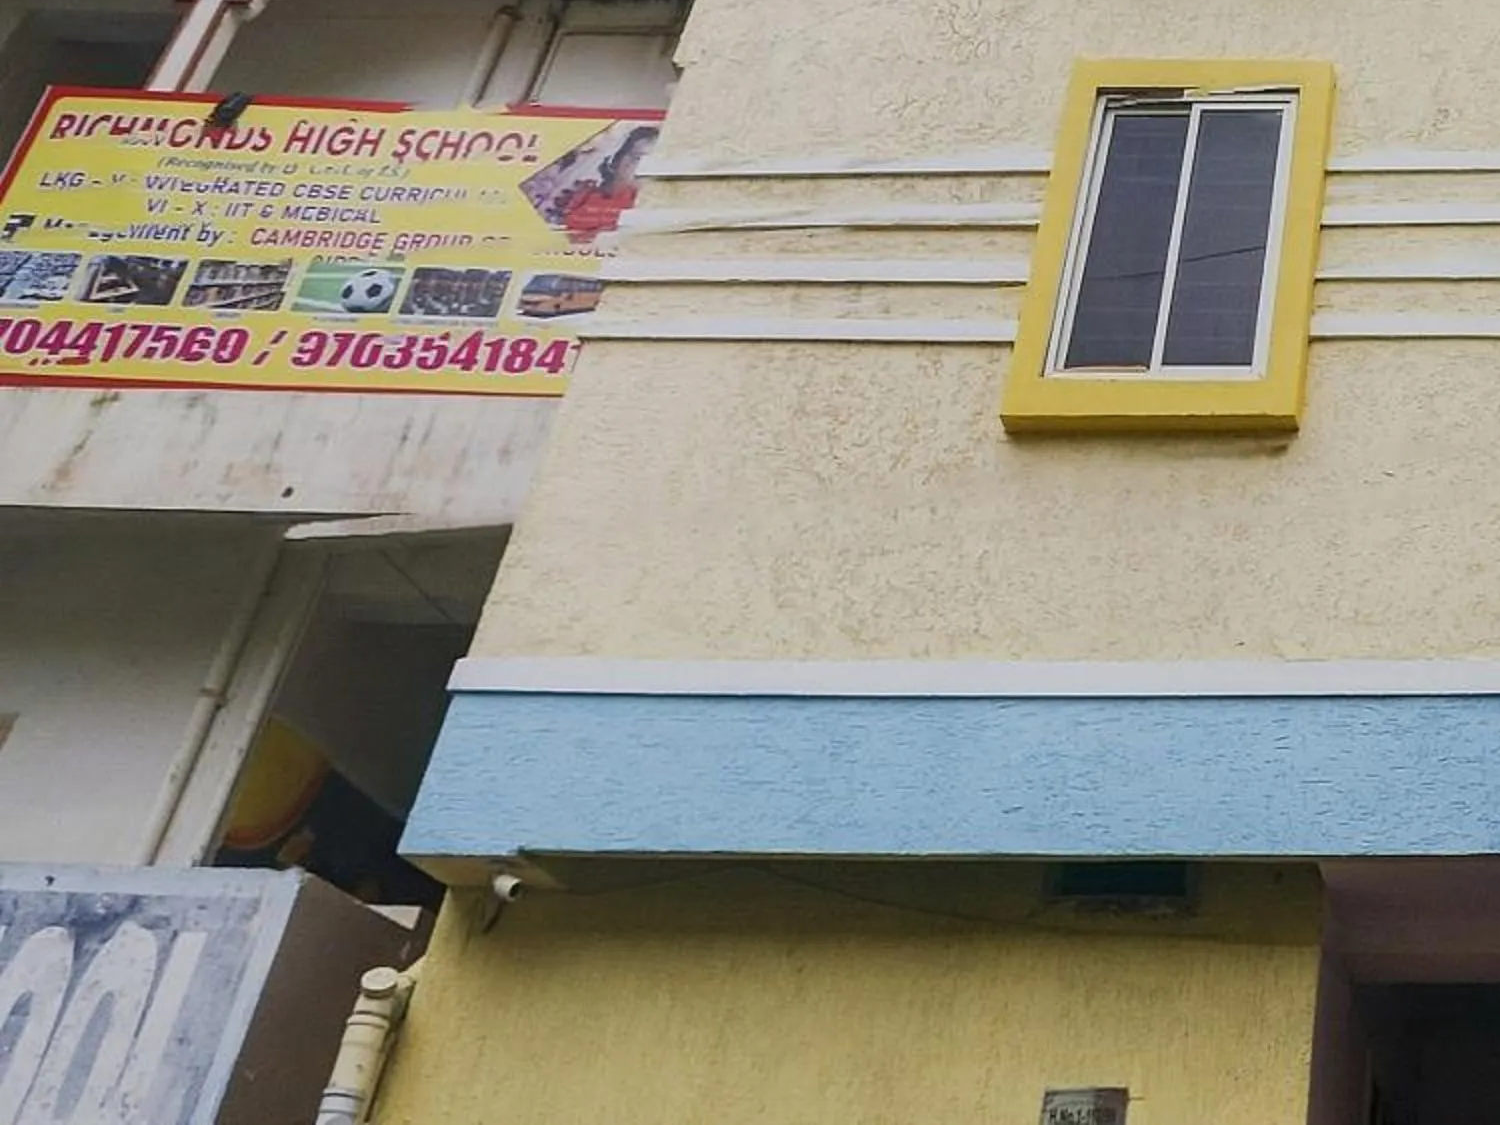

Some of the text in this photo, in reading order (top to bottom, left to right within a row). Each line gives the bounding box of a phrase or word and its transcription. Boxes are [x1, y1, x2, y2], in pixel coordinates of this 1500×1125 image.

[282, 123, 387, 158] HIGH
[40, 171, 86, 192] LKG
[292, 182, 353, 202] CBSE
[225, 202, 255, 218] IIT
[250, 228, 388, 251] CAMBRIDGE
[290, 330, 580, 374] 970354184
